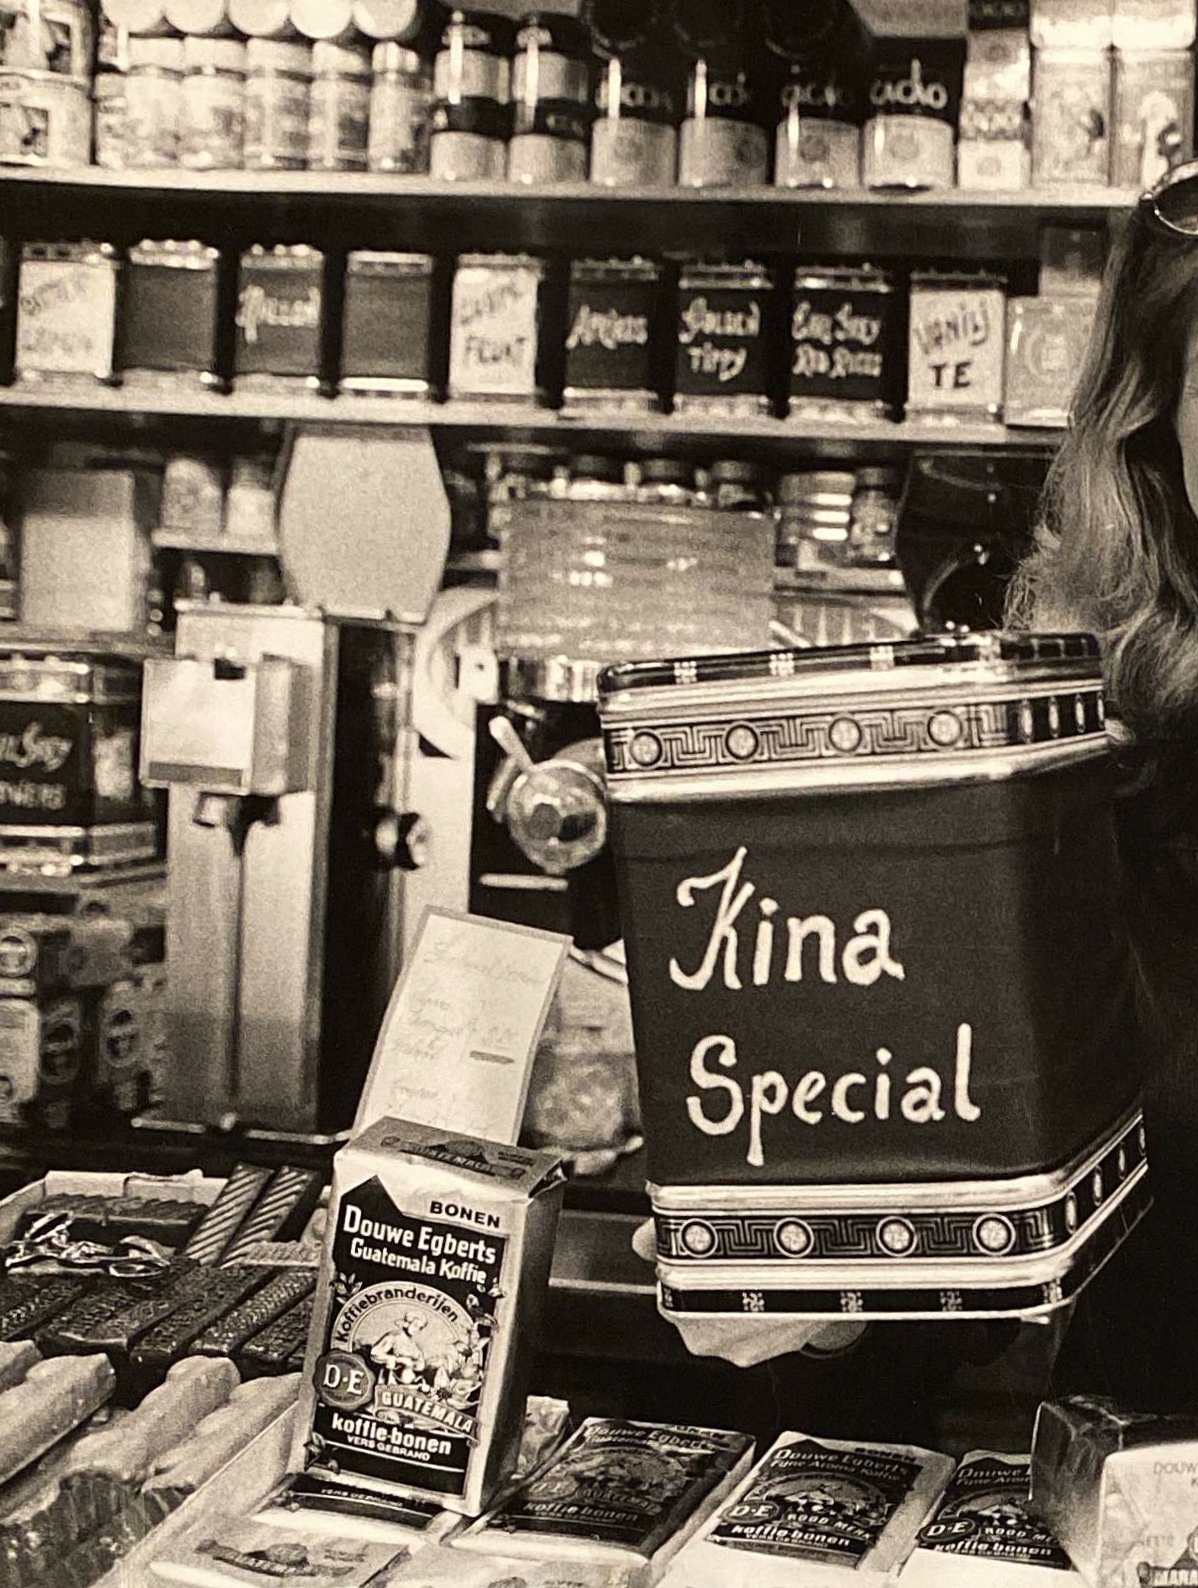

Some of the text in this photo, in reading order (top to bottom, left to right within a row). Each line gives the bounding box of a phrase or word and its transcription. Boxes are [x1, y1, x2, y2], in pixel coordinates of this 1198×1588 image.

[930, 362, 972, 388] TE
[669, 846, 906, 991] Kina
[685, 1022, 982, 1167] Special
[429, 1200, 501, 1229] BONEN
[342, 1203, 497, 1265] Douwe Egberts
[349, 1237, 487, 1285] Guatemala Koffie
[335, 1286, 459, 1344] Koffiebranderijen
[381, 1390, 474, 1434] GUATEMALA
[346, 1435, 431, 1462] VERS GEBRAND
[772, 1448, 910, 1475] Douwe Egberts
[958, 1467, 1022, 1479] Douwe
[787, 1513, 830, 1526] ROOD
[984, 1527, 1027, 1539] ROOD
